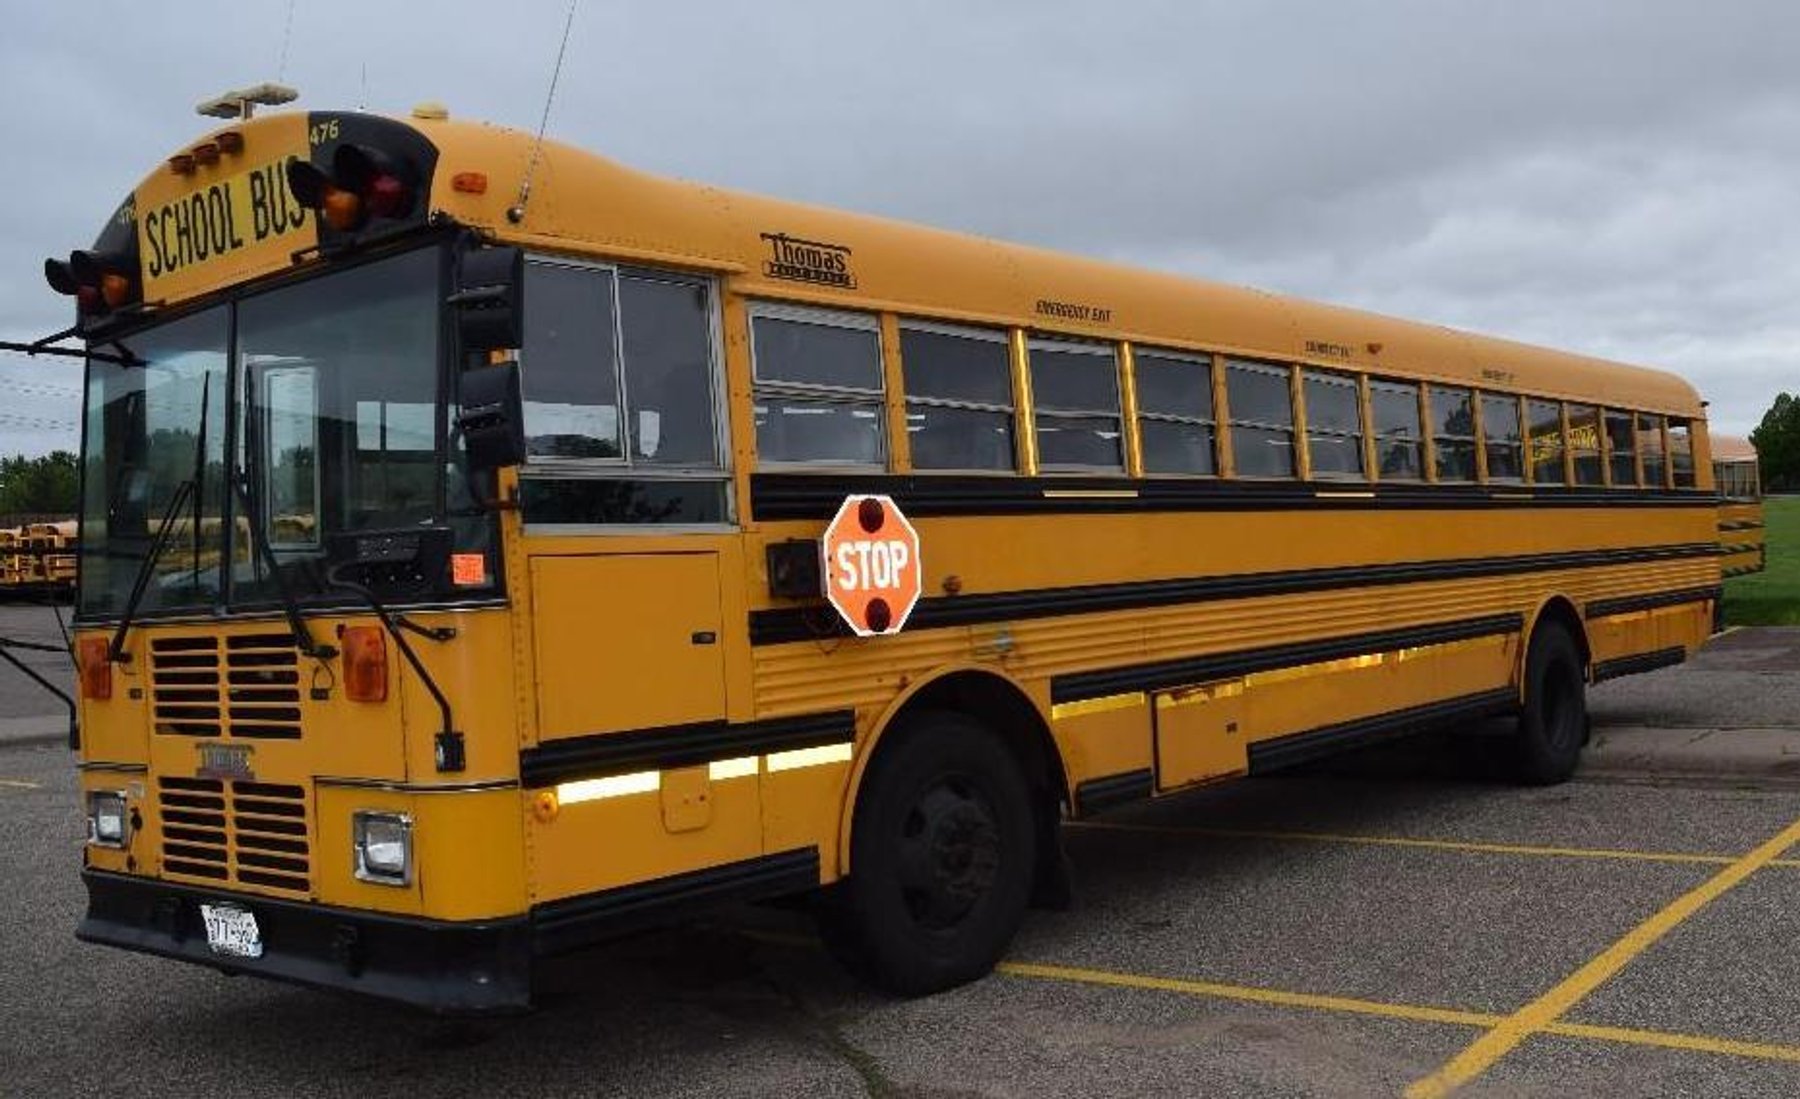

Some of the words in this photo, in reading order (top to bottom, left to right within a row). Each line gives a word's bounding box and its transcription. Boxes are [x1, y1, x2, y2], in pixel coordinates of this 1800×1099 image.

[310, 118, 339, 146] 476
[145, 181, 243, 278] SCHOOL
[760, 232, 852, 273] Thomas
[837, 540, 908, 591] STOP
